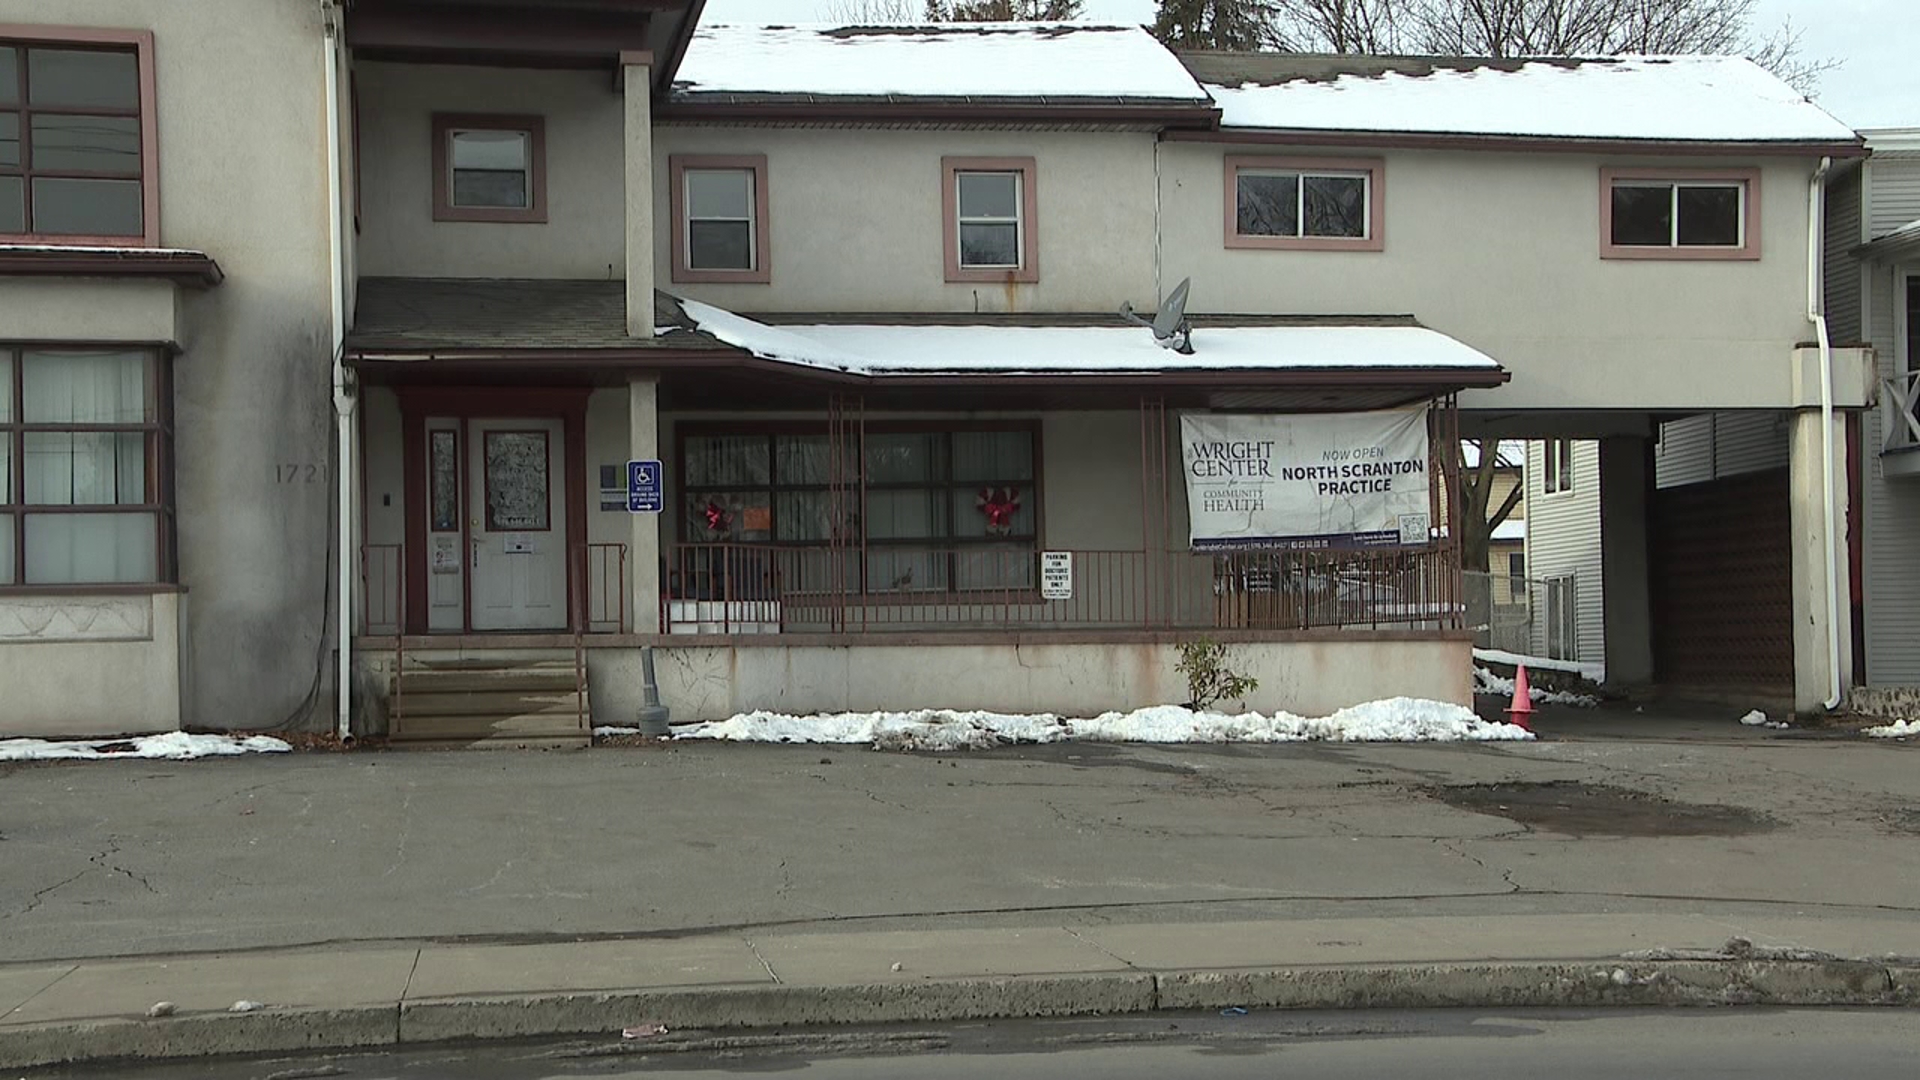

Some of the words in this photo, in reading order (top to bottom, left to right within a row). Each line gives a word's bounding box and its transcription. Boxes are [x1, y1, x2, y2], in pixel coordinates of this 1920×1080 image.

[1192, 441, 1275, 461] WRIGHT
[1322, 450, 1351, 461] NOW
[1353, 447, 1384, 460] OPEN
[1192, 459, 1275, 478] CENTER
[1282, 465, 1338, 481] NORTH
[1341, 459, 1424, 479] SCRANTON
[1203, 489, 1264, 499] COMMUNITY
[1318, 478, 1392, 495] PRACTICE
[1204, 499, 1264, 512] HEALTH
